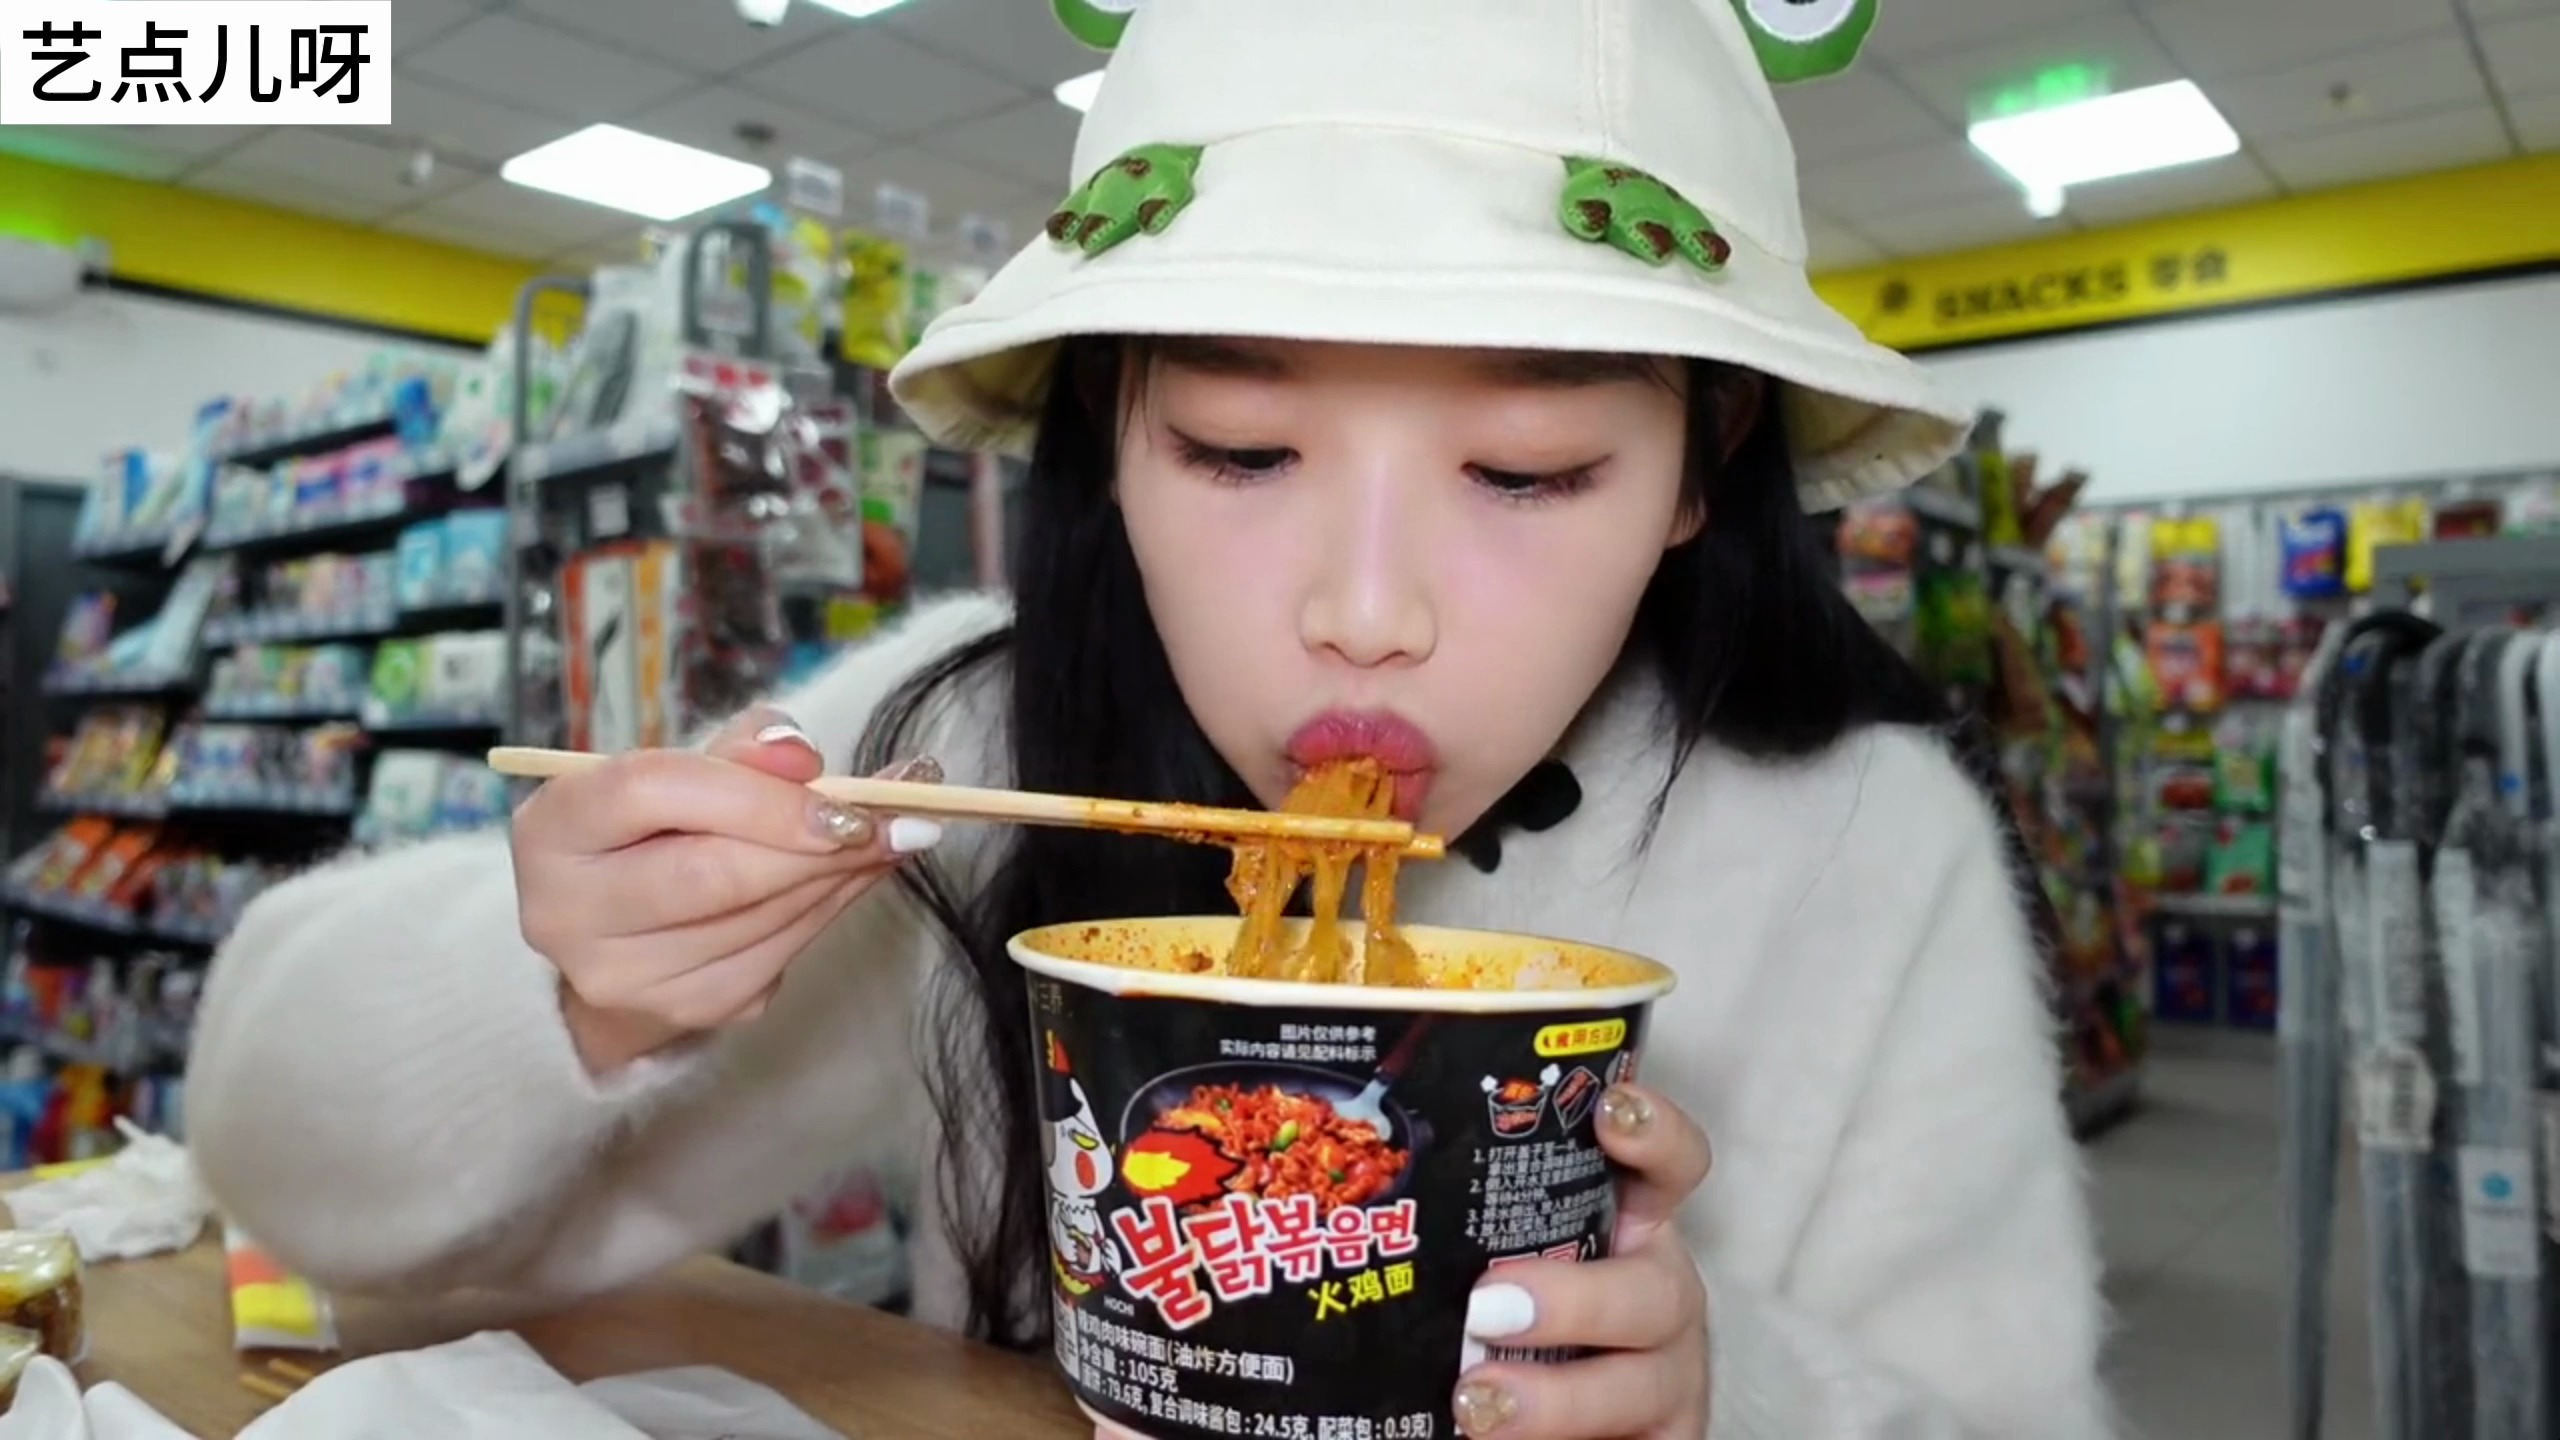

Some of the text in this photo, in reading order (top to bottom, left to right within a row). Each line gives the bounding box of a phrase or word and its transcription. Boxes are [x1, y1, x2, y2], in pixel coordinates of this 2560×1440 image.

[1280, 1024, 1376, 1042] 图片仅供参考
[1111, 1193, 1418, 1329] 불닭볶음면
[1308, 1262, 1414, 1321] 火鸡面
